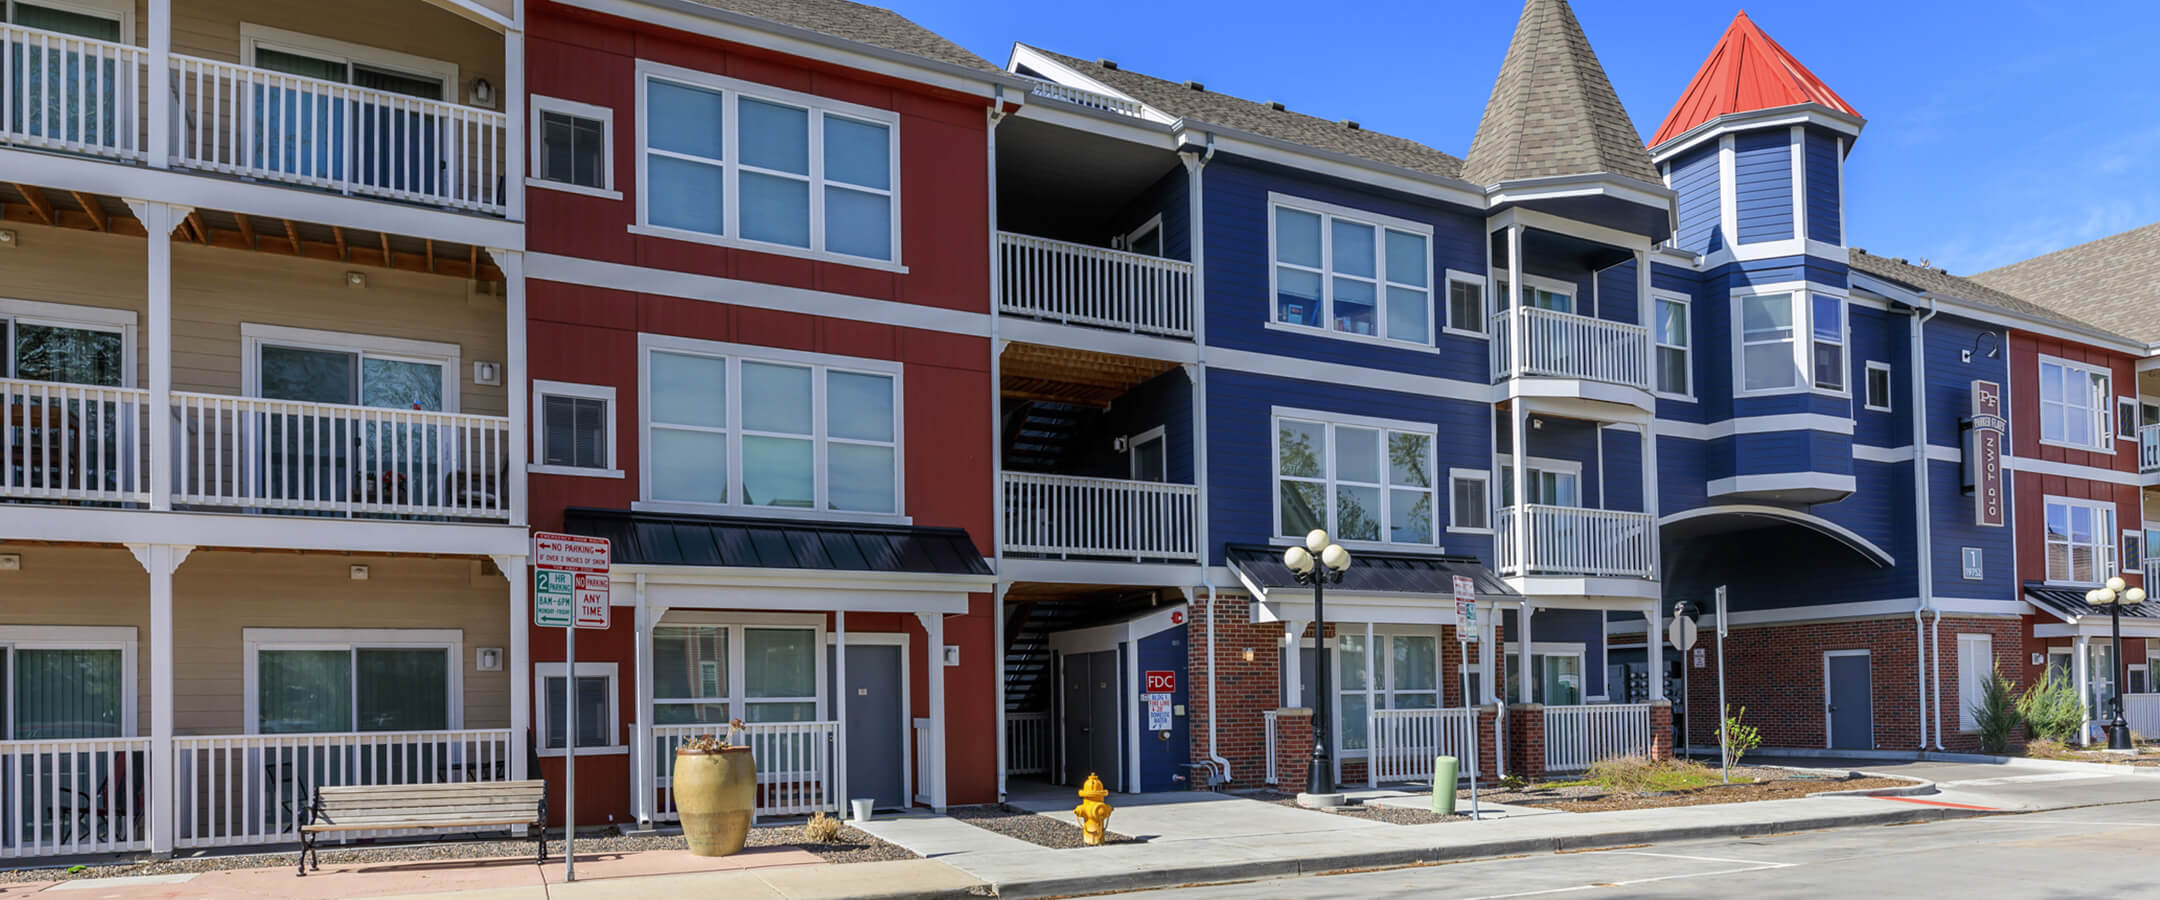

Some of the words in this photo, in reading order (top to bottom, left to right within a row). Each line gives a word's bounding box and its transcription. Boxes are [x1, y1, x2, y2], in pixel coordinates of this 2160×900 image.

[1980, 390, 1999, 408] PF
[1986, 437, 1996, 481] TOWN
[1988, 488, 1997, 516] OLD
[551, 543, 562, 552] NO
[565, 544, 595, 554] PARKING
[546, 554, 558, 562] OVER
[1970, 551, 1976, 567] 1
[538, 574, 548, 590] 2
[555, 575, 566, 583] HR
[576, 577, 585, 588] NO
[587, 579, 608, 587] PARKING
[549, 583, 570, 591] PARKING
[584, 593, 601, 604] ANY
[582, 606, 602, 617] TIME
[1148, 675, 1174, 688] FDC
